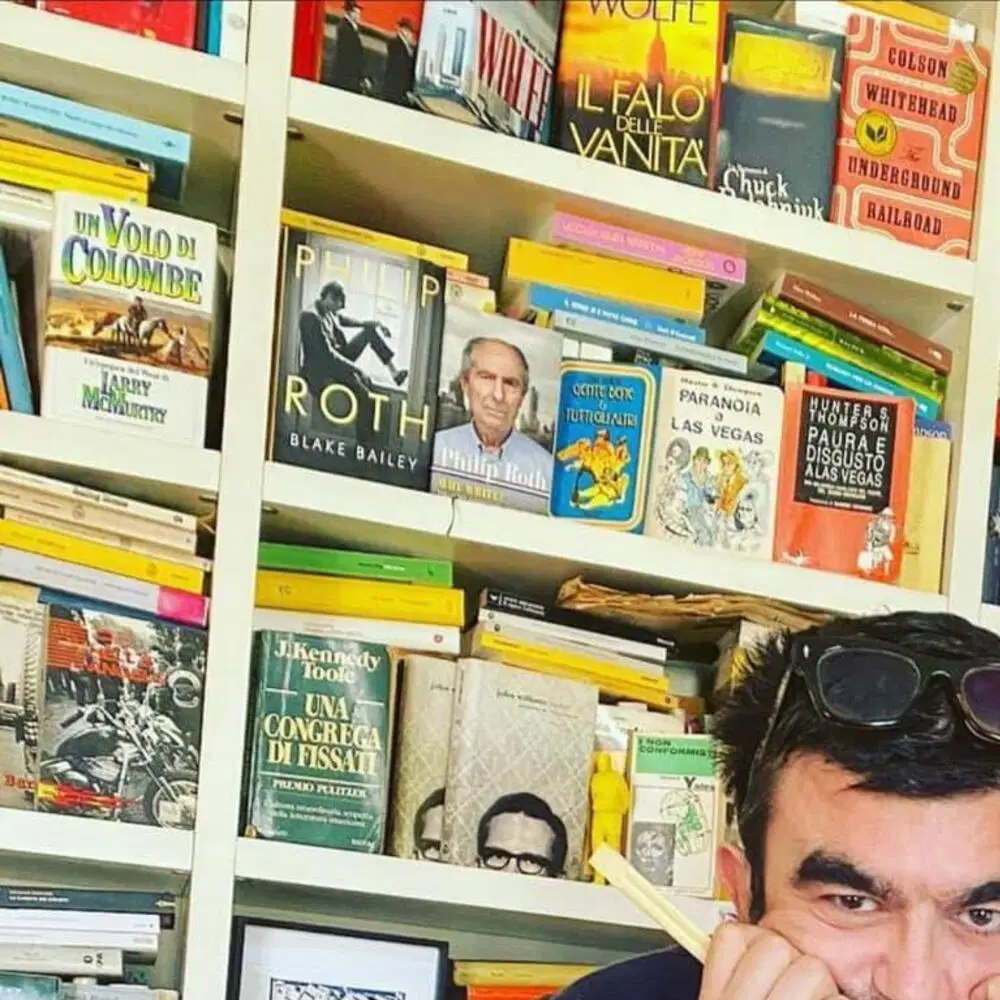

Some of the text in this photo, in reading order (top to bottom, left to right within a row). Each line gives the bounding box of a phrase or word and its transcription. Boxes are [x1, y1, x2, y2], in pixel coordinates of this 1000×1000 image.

[887, 47, 948, 79] COLSON
[577, 73, 604, 112] IL
[866, 83, 958, 124] WHITEHEAD
[616, 116, 663, 136] DELLE
[723, 163, 789, 201] Chuck
[848, 155, 962, 200] UNDERGROUND
[74, 203, 196, 261] UN VOLO DI
[867, 202, 942, 237] RAILROAD
[61, 236, 203, 304] COLOMBE
[296, 245, 440, 308] PHILIP
[285, 375, 430, 442] ROTH
[679, 388, 762, 417] PARANOIA
[809, 396, 872, 419] HUNTER
[671, 415, 765, 446] LAS VEGAS
[808, 408, 889, 433] THOMPSON
[290, 432, 419, 472] BLAKE BAILEY
[808, 426, 887, 455] PAURA E
[440, 447, 548, 490] Philip Roth
[806, 444, 886, 473] DISGUSTO
[841, 468, 884, 488] VEGAS
[301, 657, 355, 684] Toole
[305, 692, 349, 721] UNA
[263, 713, 383, 751] CONGREGA
[267, 738, 378, 777] DI FISSATI
[272, 778, 367, 799] PREMIO PULITZER
